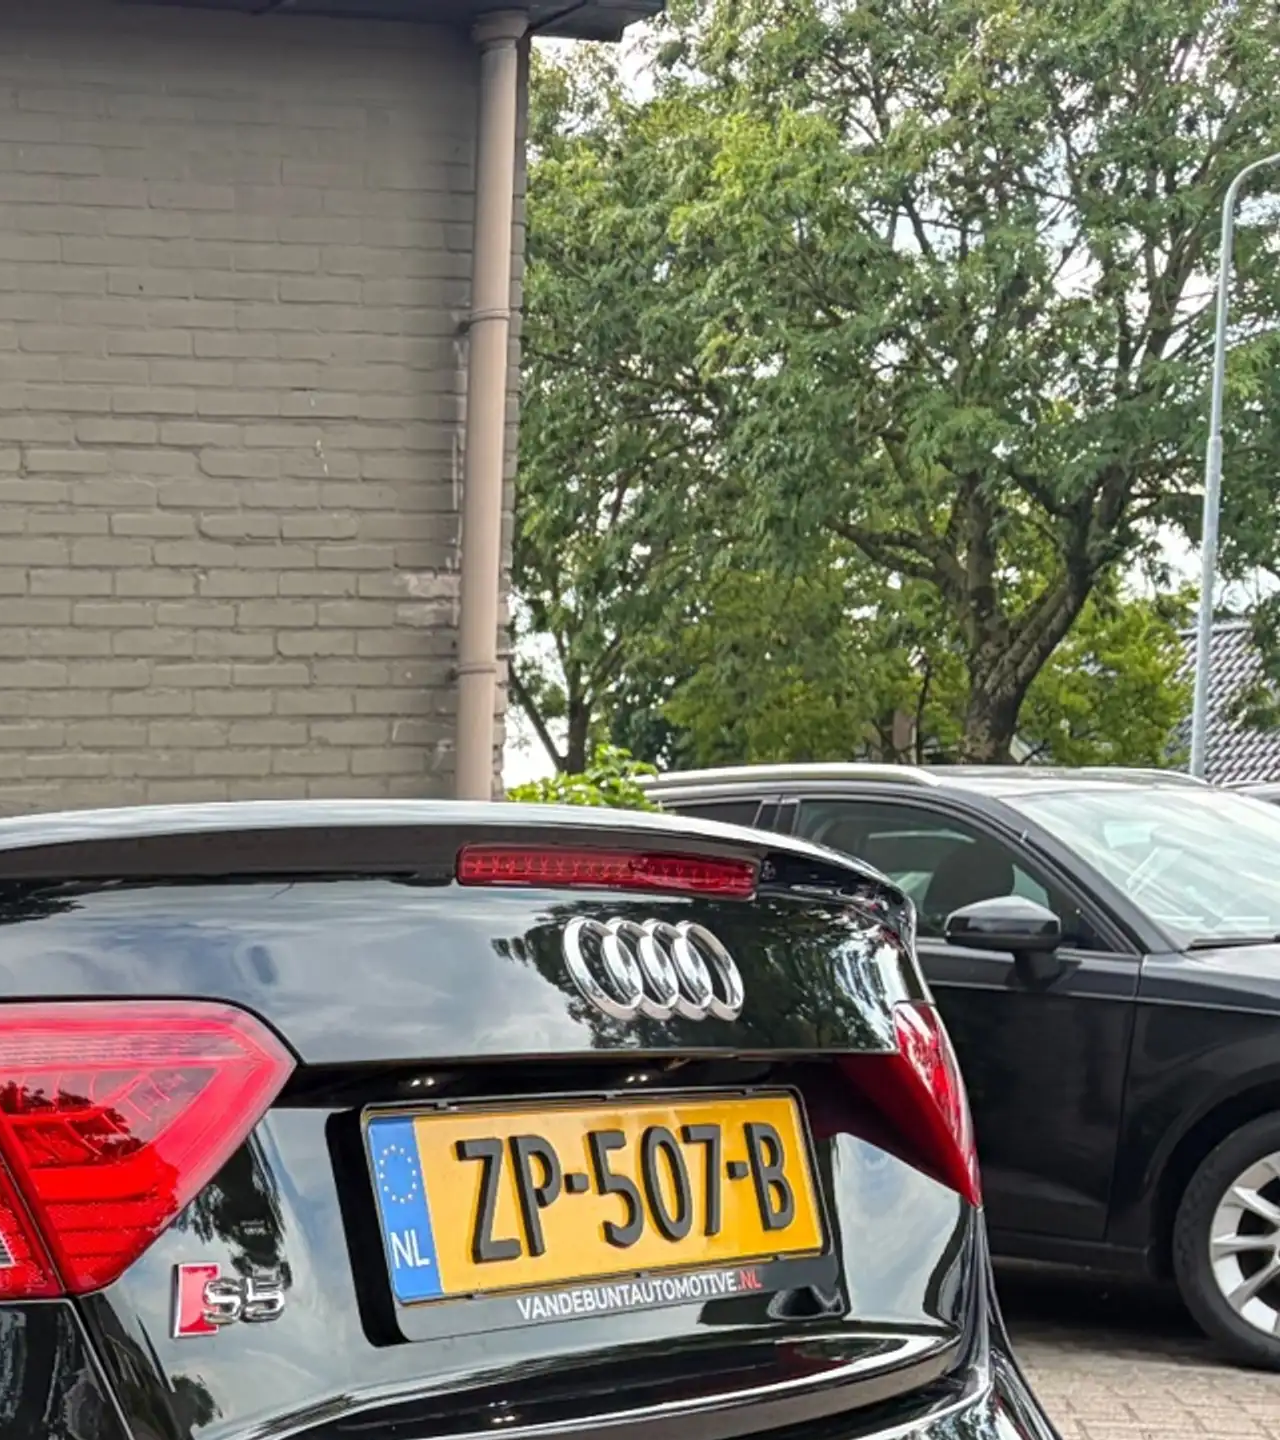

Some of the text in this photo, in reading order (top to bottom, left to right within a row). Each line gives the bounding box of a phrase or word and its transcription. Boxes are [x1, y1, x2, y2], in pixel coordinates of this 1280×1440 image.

[455, 1122, 796, 1264] ZP-507-B
[390, 1231, 430, 1268] NL
[202, 1277, 286, 1325] S5
[516, 1268, 763, 1321] VANDEBUNTAUTOMOTIVE.NL
